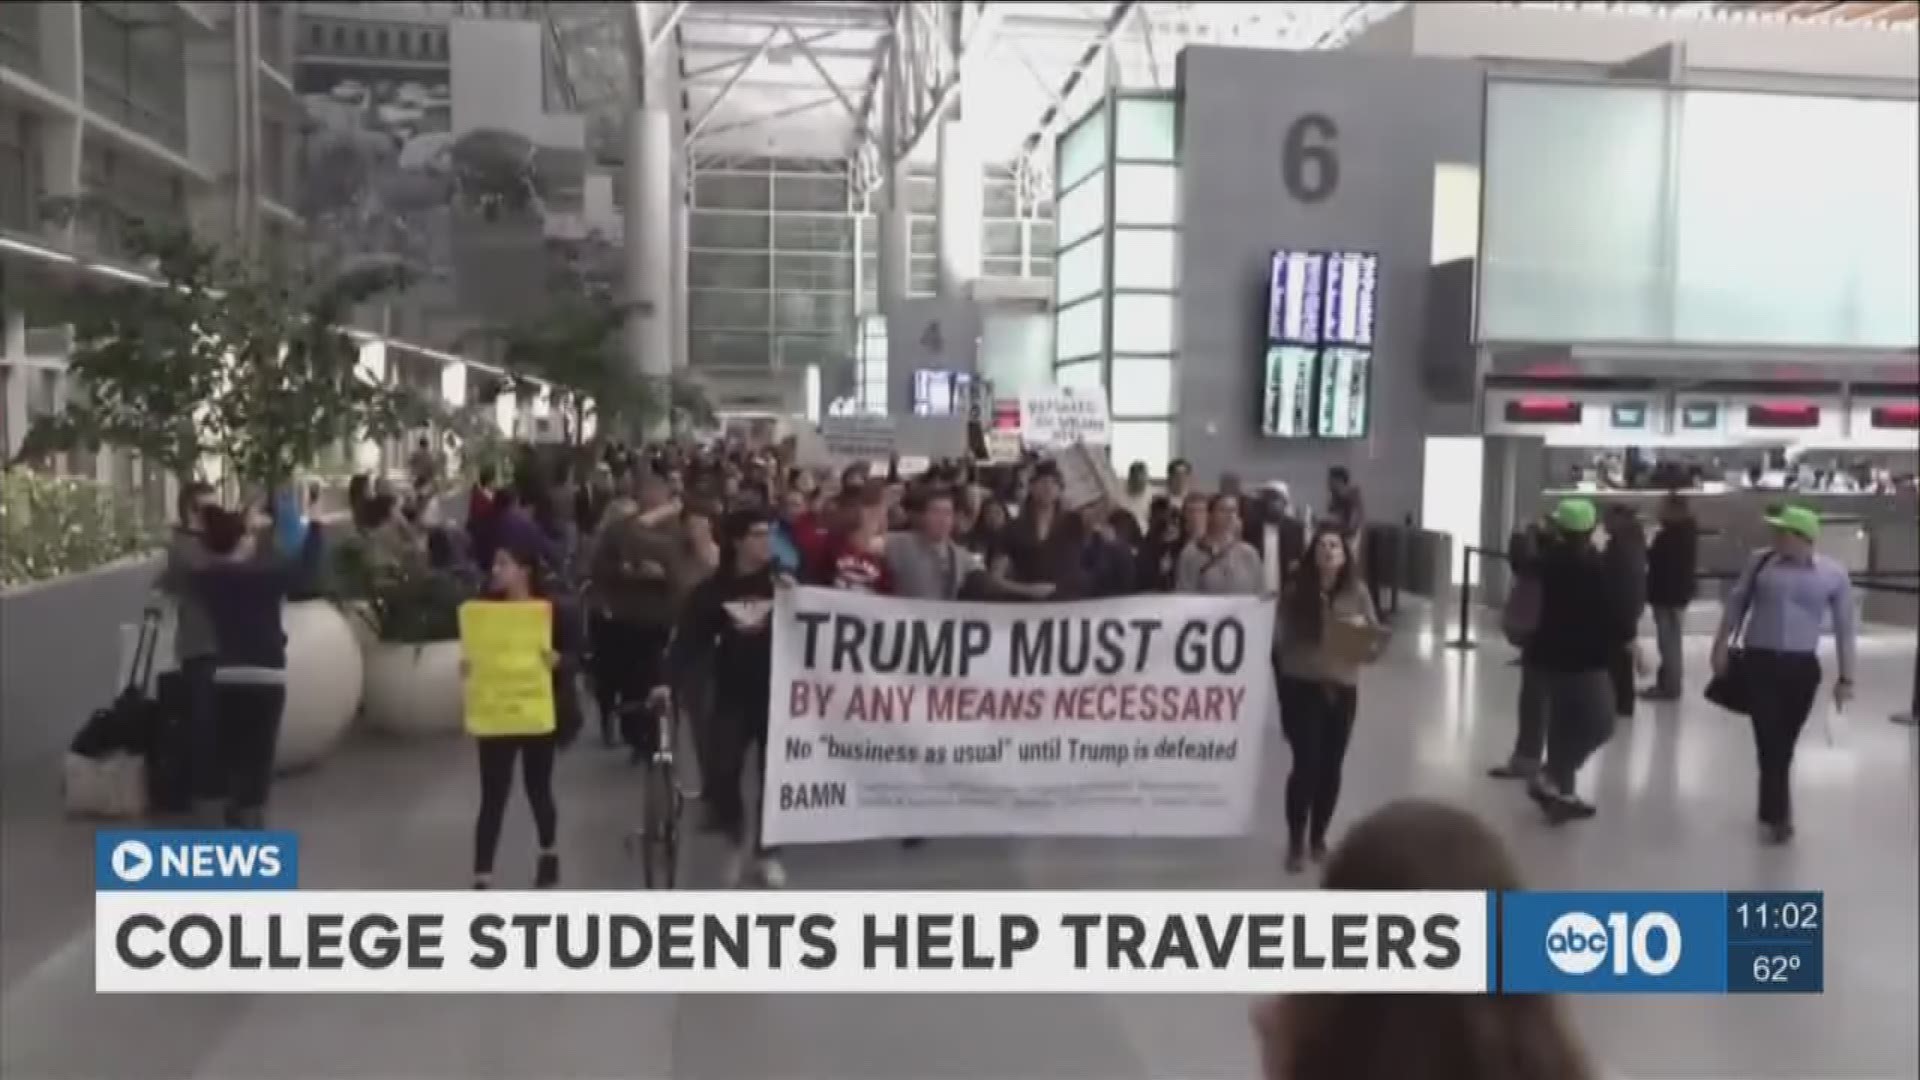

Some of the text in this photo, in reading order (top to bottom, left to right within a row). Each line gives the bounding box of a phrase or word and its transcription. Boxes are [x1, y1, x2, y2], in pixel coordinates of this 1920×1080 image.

[1281, 112, 1340, 204] 6
[919, 319, 943, 353] 4
[796, 613, 1246, 677] TRUMP MUST GO
[789, 681, 1246, 722] BY ANY MEANS NECESSARY
[785, 734, 1238, 765] No "business as usual" until Trump is defeated
[779, 784, 846, 811] BAMN
